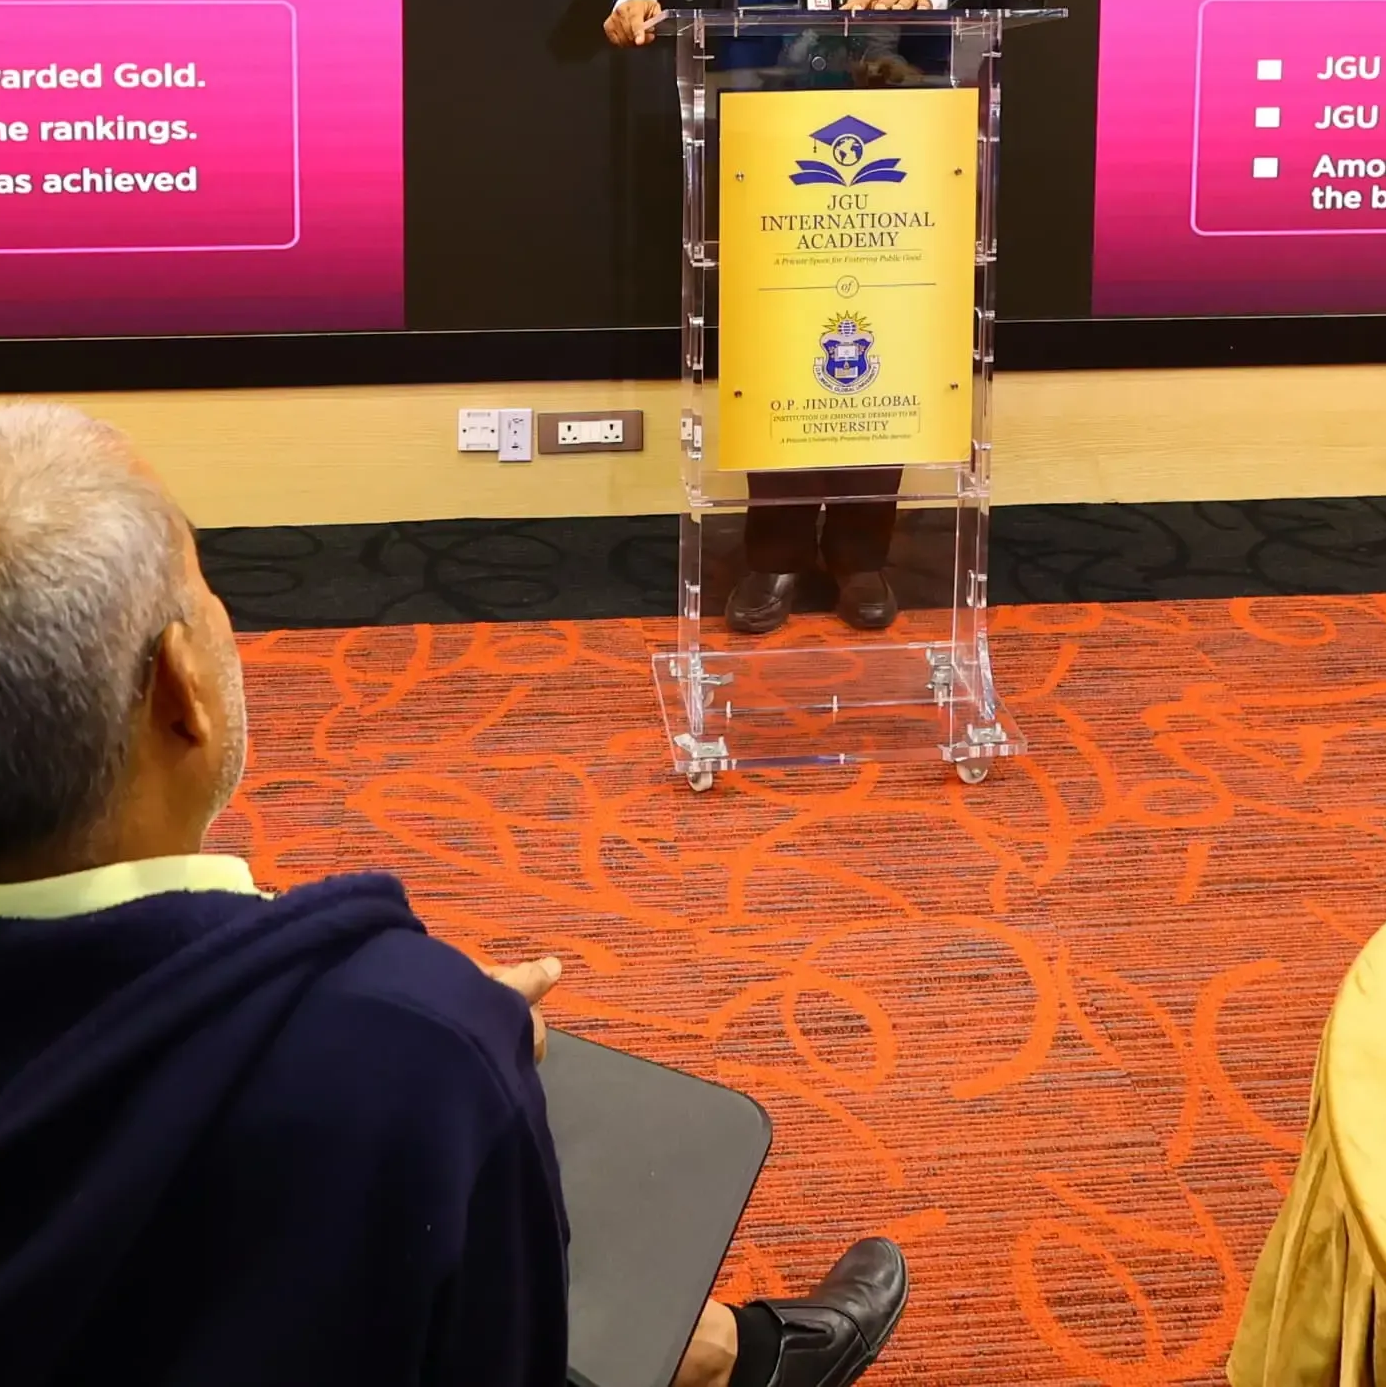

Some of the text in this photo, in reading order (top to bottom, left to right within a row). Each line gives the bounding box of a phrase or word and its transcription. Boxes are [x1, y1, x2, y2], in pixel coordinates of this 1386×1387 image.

[114, 63, 205, 87] Gold.
[1317, 56, 1380, 79] JGU
[1315, 106, 1378, 129] JGU
[41, 116, 196, 144] rankings.
[43, 167, 196, 193] achieved
[827, 194, 869, 210] JGU
[1312, 186, 1361, 209] the
[760, 212, 935, 231] INTERNATIONAL
[797, 231, 899, 249] ACADEMY
[841, 281, 852, 293] of
[770, 395, 921, 411] O.P. JINDAL GLOBAL
[803, 420, 889, 434] UNIVERSITY
